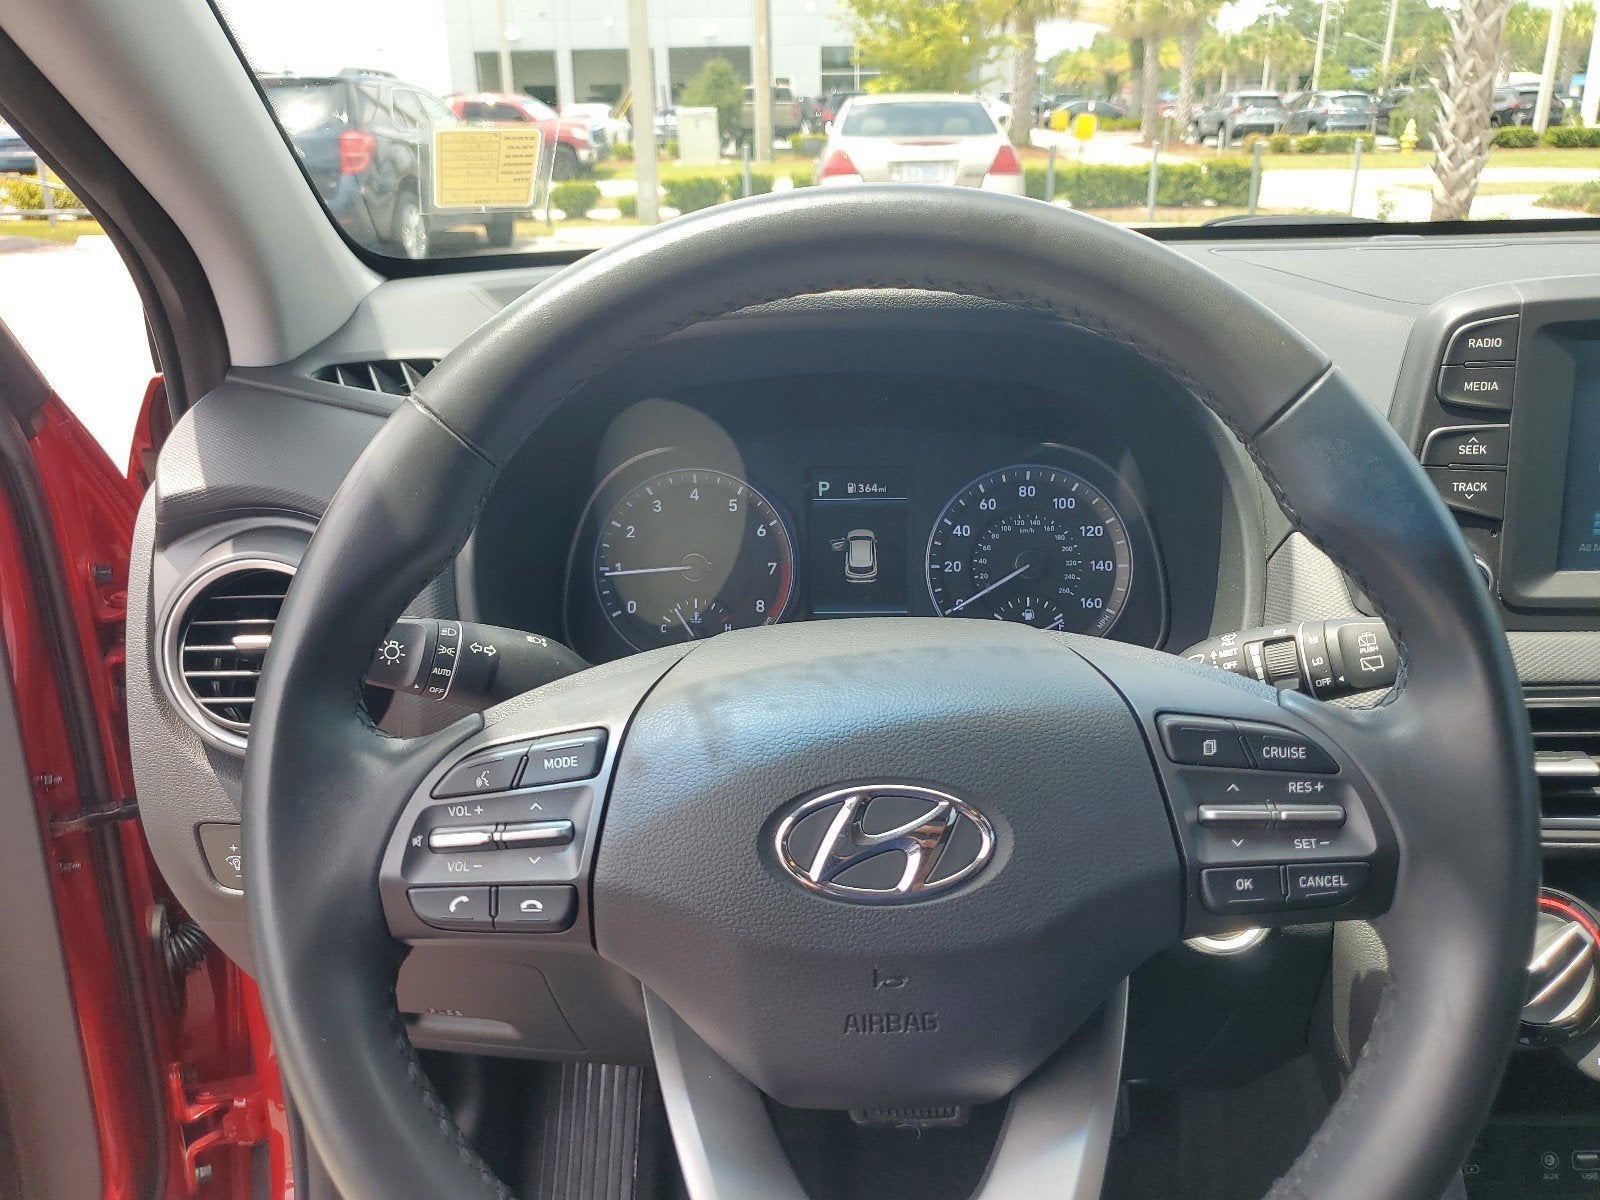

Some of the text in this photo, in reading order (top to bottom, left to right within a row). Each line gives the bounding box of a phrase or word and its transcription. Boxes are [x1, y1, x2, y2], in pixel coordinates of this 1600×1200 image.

[1468, 338, 1502, 348] RADIO
[1464, 381, 1498, 391] MEDIA
[1458, 444, 1487, 455] SEEK
[818, 481, 830, 496] P
[1018, 486, 1036, 498] 80
[1452, 482, 1488, 492] TRACK
[690, 488, 700, 500] 4
[652, 500, 662, 512] 3
[728, 499, 738, 512] 5
[979, 498, 996, 510] 60
[1052, 498, 1076, 510] 100
[626, 526, 636, 538] 2
[756, 525, 766, 538] 6
[952, 525, 971, 537] 40
[1080, 526, 1104, 537] 120
[614, 562, 622, 572] 1
[768, 562, 778, 575] 7
[944, 561, 962, 572] 20
[1090, 560, 1113, 572] 140
[627, 600, 637, 614] 0
[756, 600, 766, 612] 8
[1080, 598, 1102, 609] 160
[1096, 614, 1110, 629] MPH
[661, 624, 668, 633] C
[724, 624, 732, 632] H
[1360, 645, 1378, 654] PUSH
[1222, 660, 1238, 670] OFF
[1312, 656, 1324, 666] LO
[432, 667, 451, 676] AUTO
[1315, 677, 1332, 688] OFF
[429, 686, 445, 694] OFF
[1262, 746, 1306, 758] CRUISE
[544, 756, 578, 770] MODE
[448, 805, 472, 816] VOL
[1294, 838, 1317, 849] SET
[447, 862, 470, 872] VOL
[1236, 878, 1254, 890] OK
[1298, 876, 1348, 888] CANCEL
[844, 1012, 938, 1034] AIRBAG
